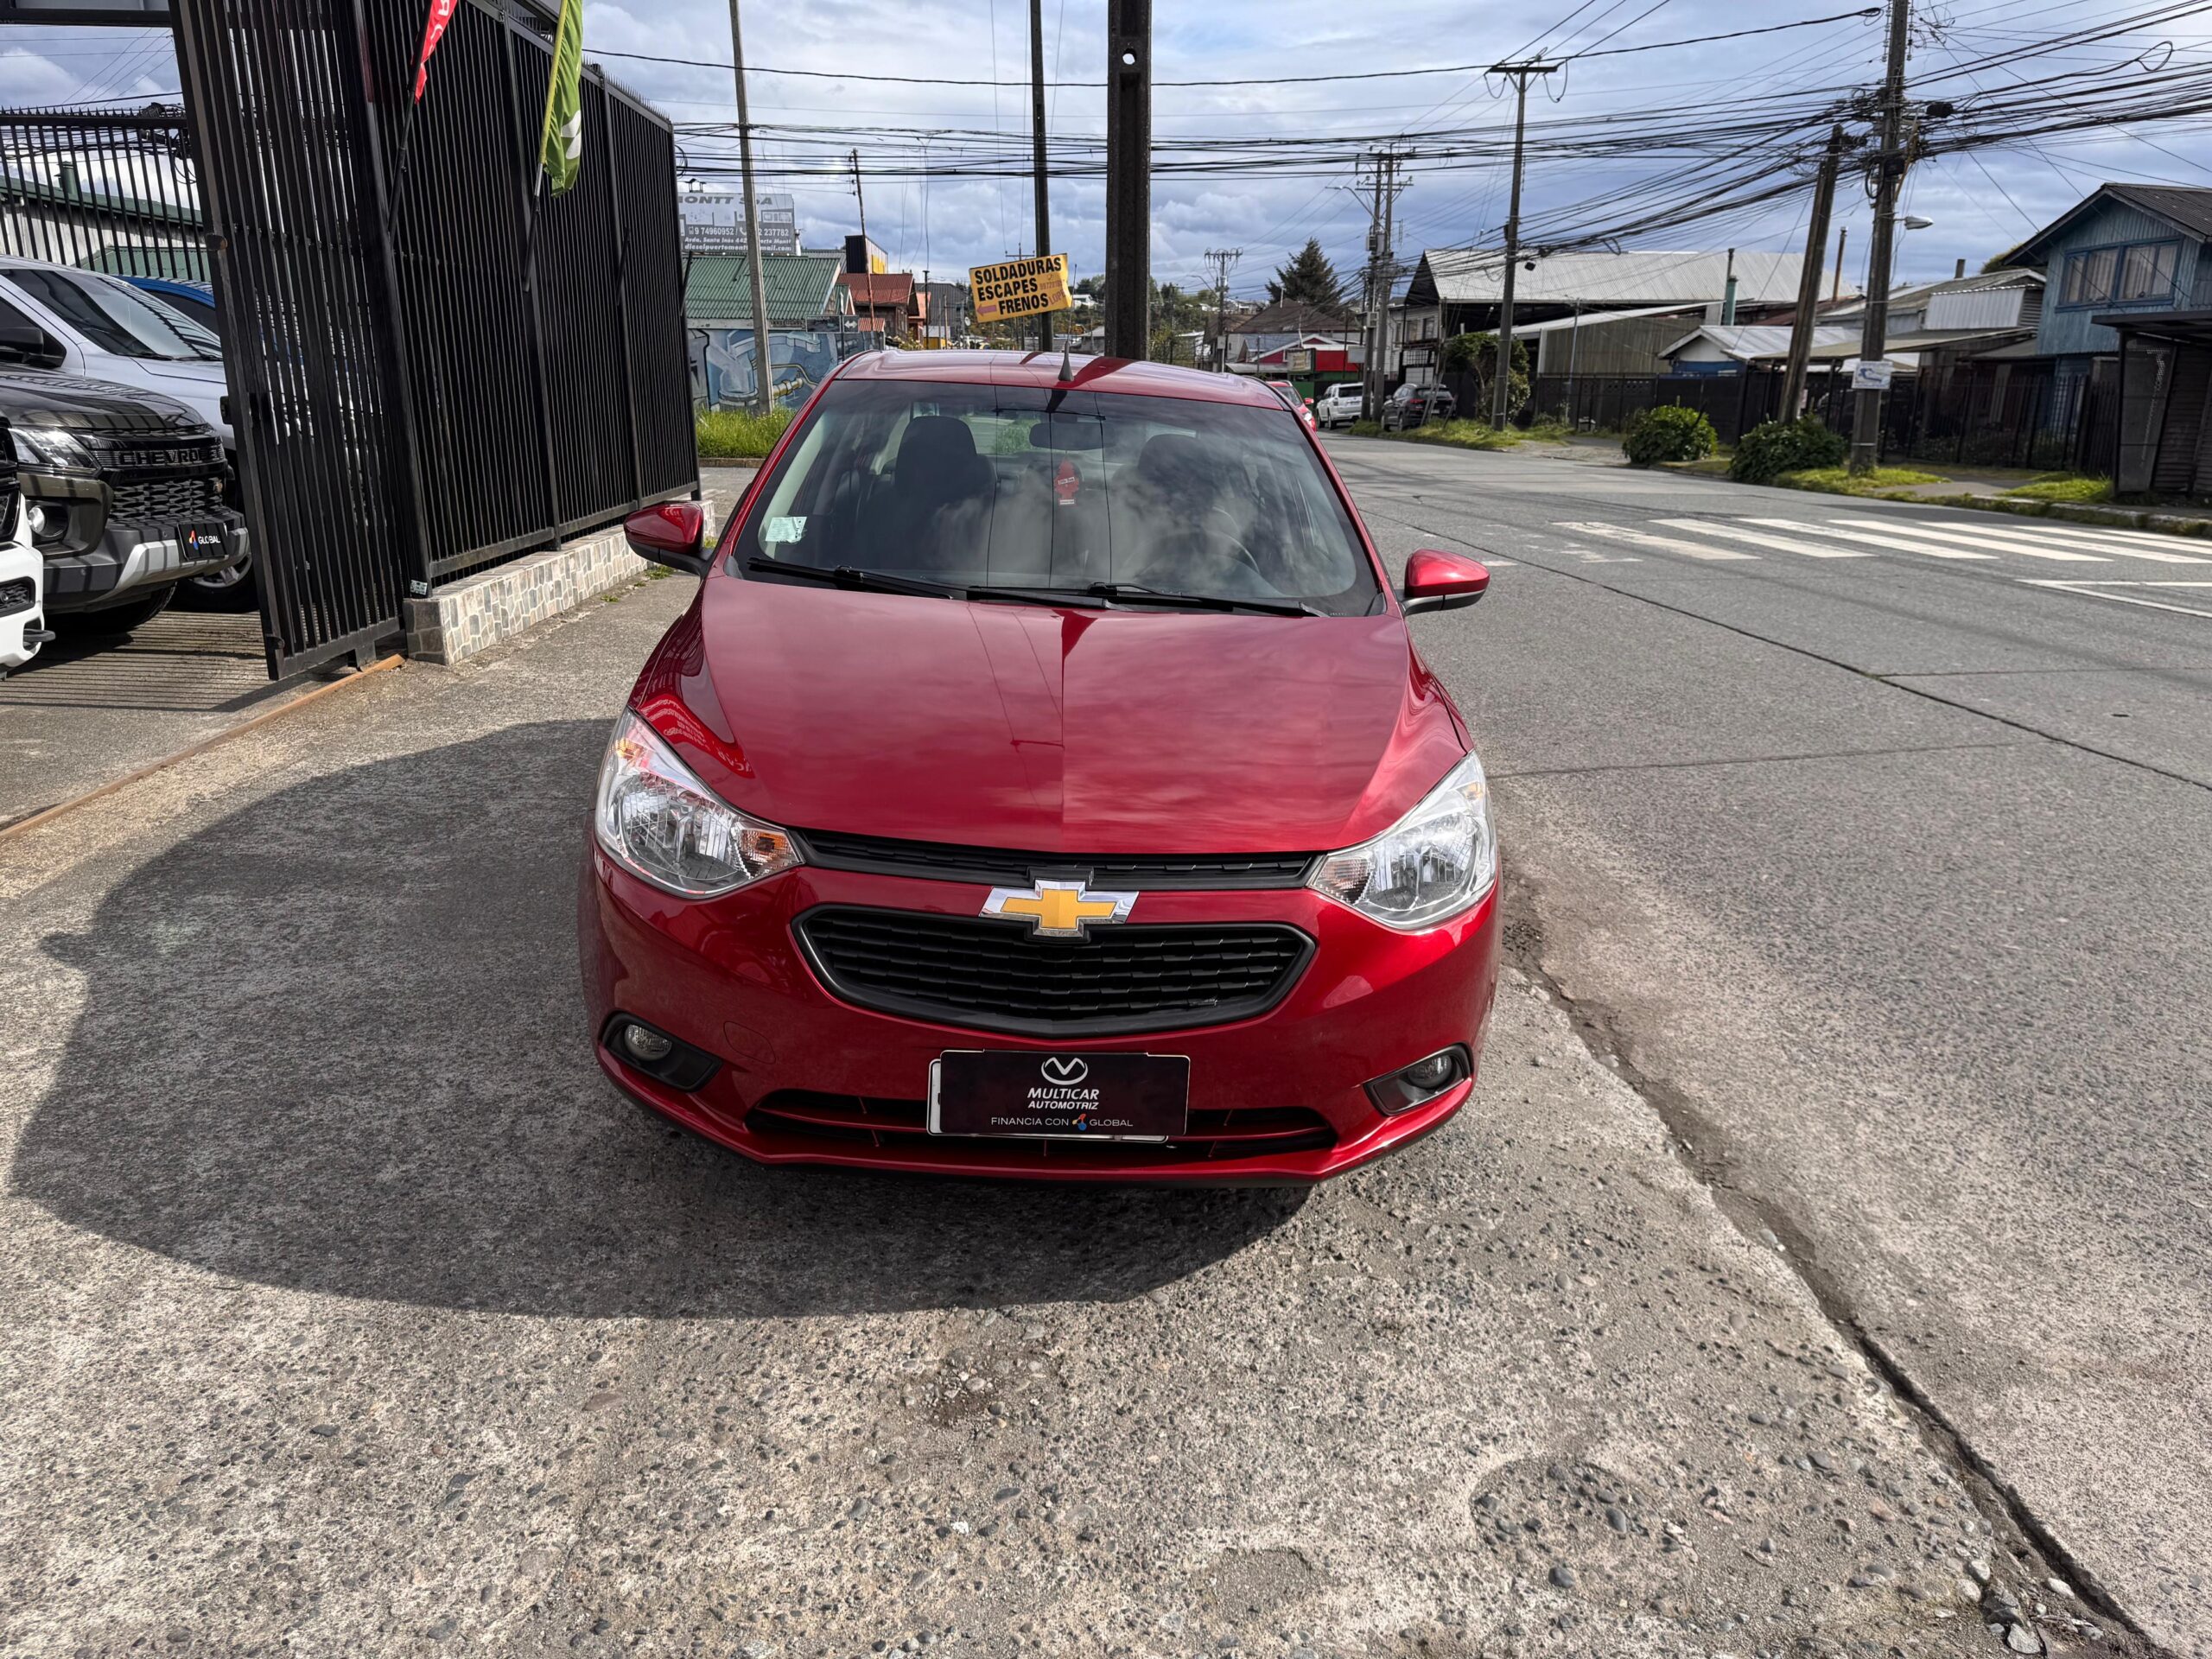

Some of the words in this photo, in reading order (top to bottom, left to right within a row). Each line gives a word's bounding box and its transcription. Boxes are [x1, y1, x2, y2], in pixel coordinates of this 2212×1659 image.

[764, 228, 790, 237] 237782
[975, 257, 1062, 285] SOLDADURAS
[977, 277, 1038, 302] ESCAPES
[998, 293, 1049, 315] FRENOS
[198, 535, 221, 544] GLOBAL
[1027, 1087, 1100, 1101] MULTICAR
[1027, 1100, 1100, 1110] AUTOMOTRIZ
[990, 1116, 1043, 1127] FINANCIA
[1045, 1117, 1070, 1127] CON
[1089, 1118, 1134, 1128] GLOBAL
